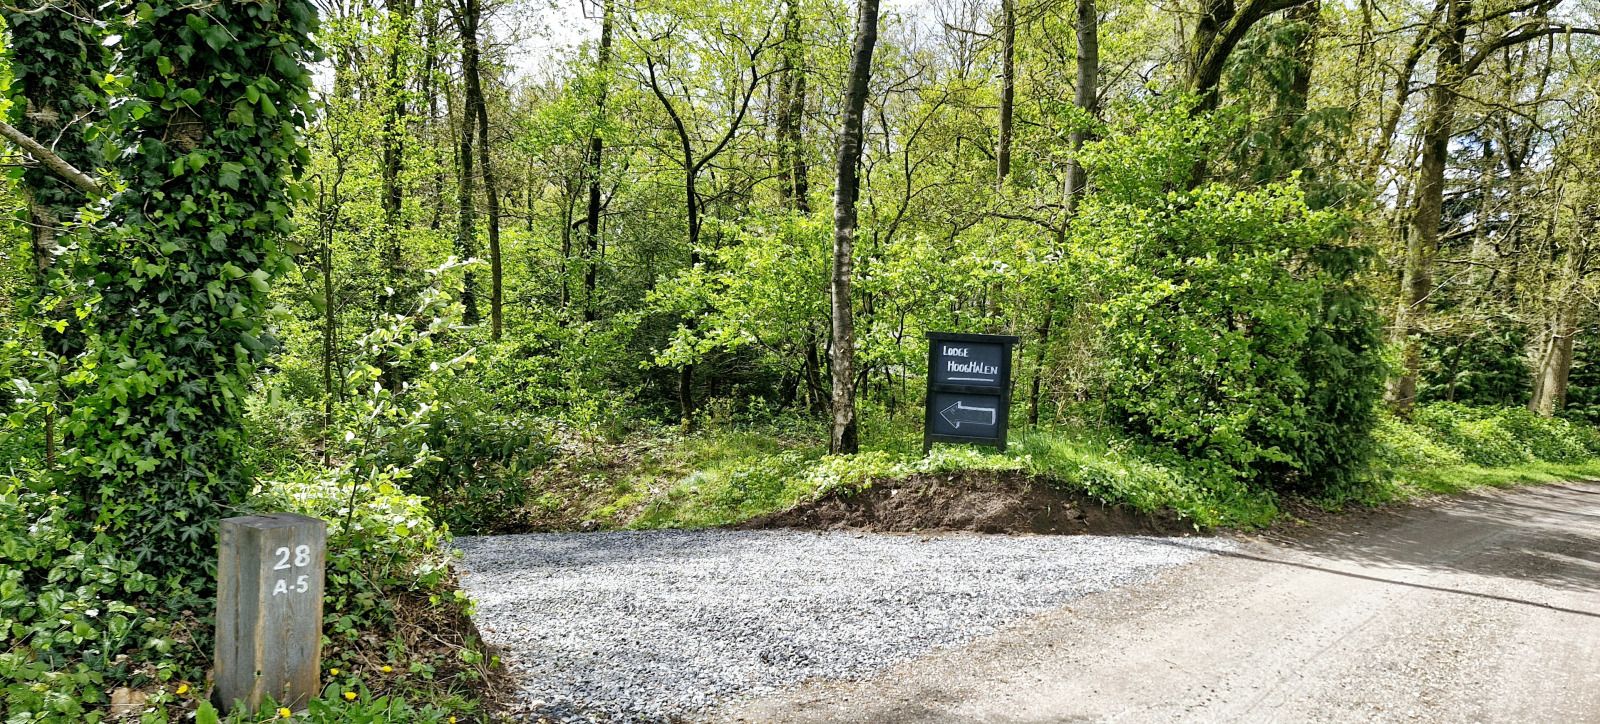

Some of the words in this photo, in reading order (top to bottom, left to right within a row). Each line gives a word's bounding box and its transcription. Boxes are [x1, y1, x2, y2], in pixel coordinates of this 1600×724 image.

[943, 345, 969, 358] LODGE
[947, 360, 998, 375] HOOGHALEN
[273, 544, 311, 571] 28
[272, 574, 310, 597] A-5
